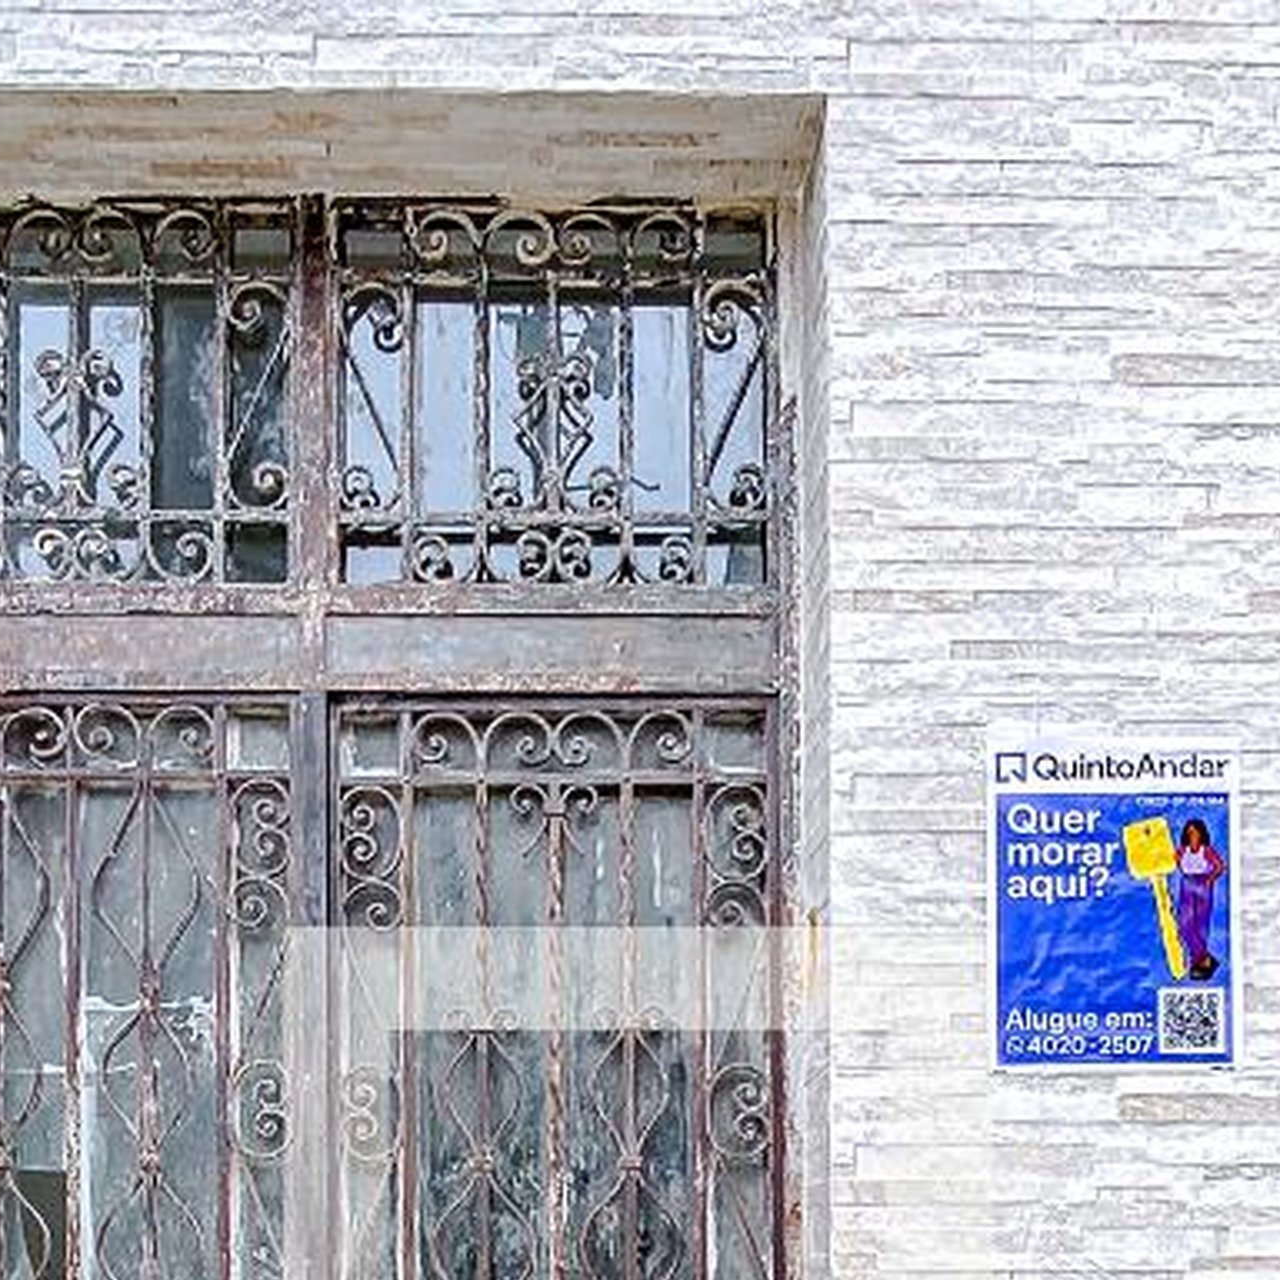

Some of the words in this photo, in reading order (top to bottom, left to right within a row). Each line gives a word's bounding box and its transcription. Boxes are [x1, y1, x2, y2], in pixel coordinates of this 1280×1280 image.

[1033, 753, 1230, 781] QuintoAndar
[1006, 804, 1101, 834] Quer
[1006, 840, 1118, 866] morar
[1006, 866, 1110, 904] aqui?
[1005, 1007, 1098, 1034] Alugue
[1105, 1011, 1153, 1029] em:
